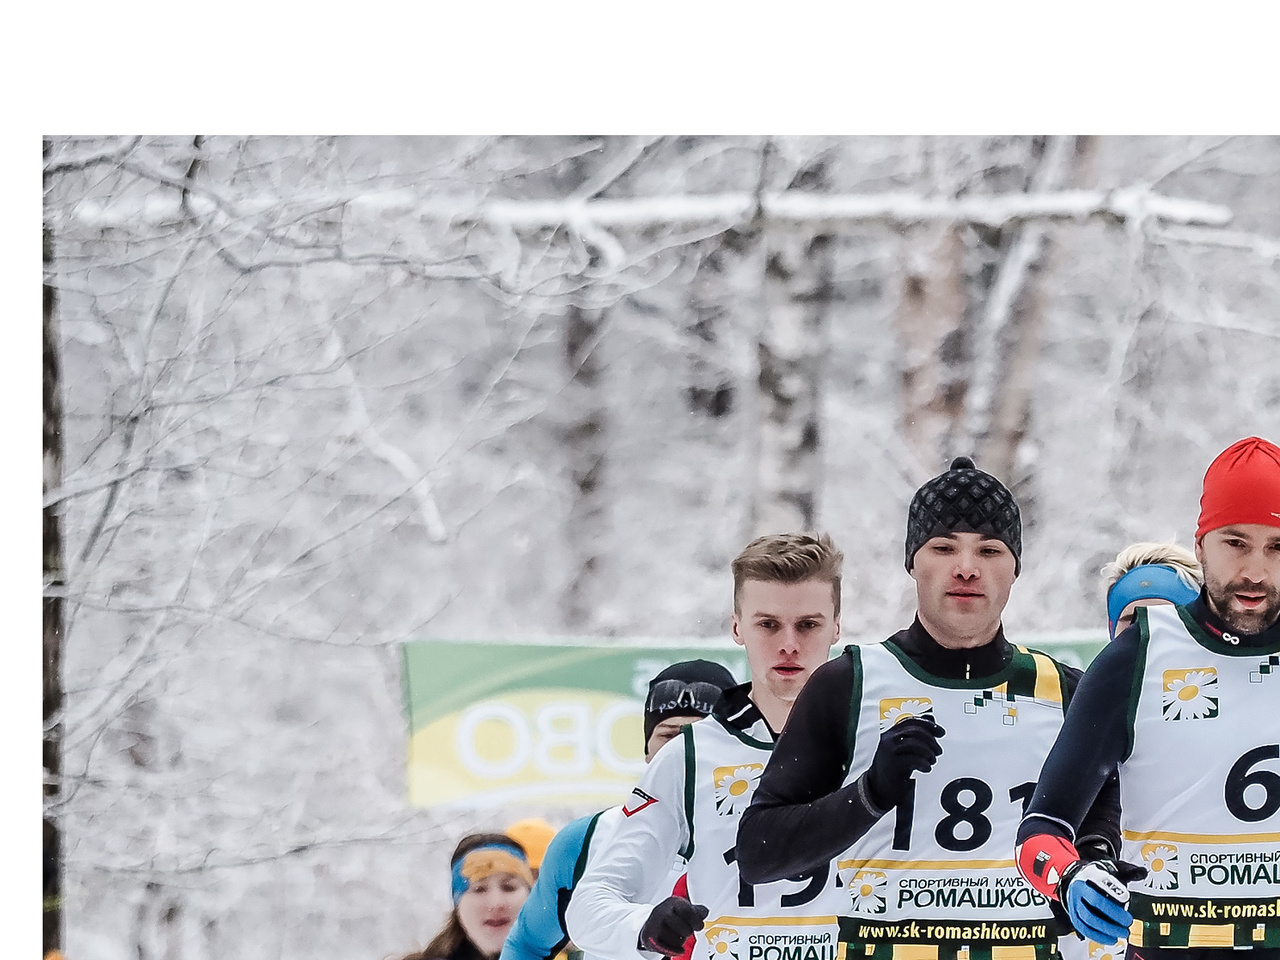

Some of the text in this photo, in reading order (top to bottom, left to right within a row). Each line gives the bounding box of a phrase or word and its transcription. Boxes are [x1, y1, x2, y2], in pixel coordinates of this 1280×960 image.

[899, 877, 1024, 889] СПОРТИВНЫЙ КЛУБ
[859, 921, 1047, 940] www.sk-romashkovo.ru
[748, 933, 832, 945] СПОРТИВНЫЙ
